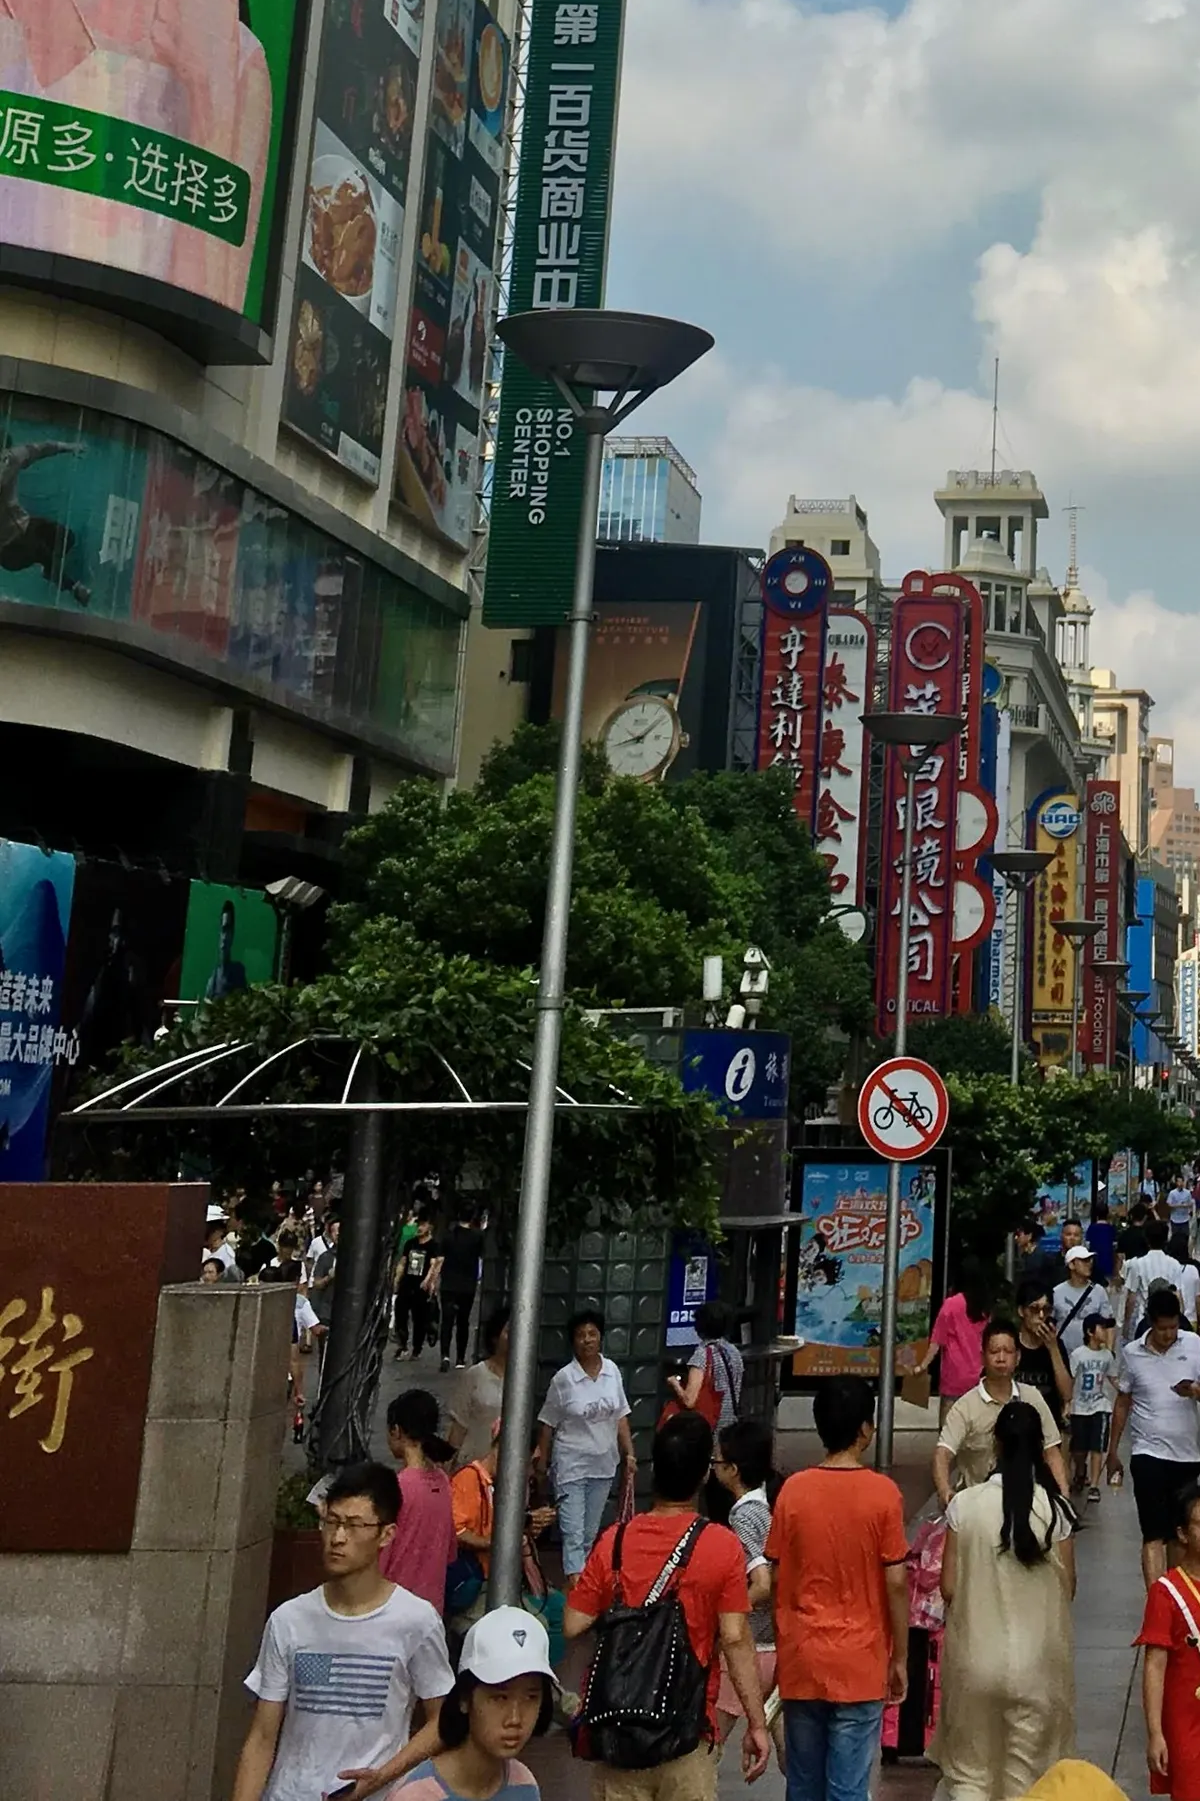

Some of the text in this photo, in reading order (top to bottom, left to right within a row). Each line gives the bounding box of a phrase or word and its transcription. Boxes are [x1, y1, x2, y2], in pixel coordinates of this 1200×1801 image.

[510, 408, 532, 497] CENTER
[554, 408, 574, 456] NO.1
[528, 408, 554, 524] SHOPPING
[1041, 813, 1081, 825] BAC
[886, 998, 941, 1013] OTICAL
[1093, 996, 1105, 1054] Foodhall
